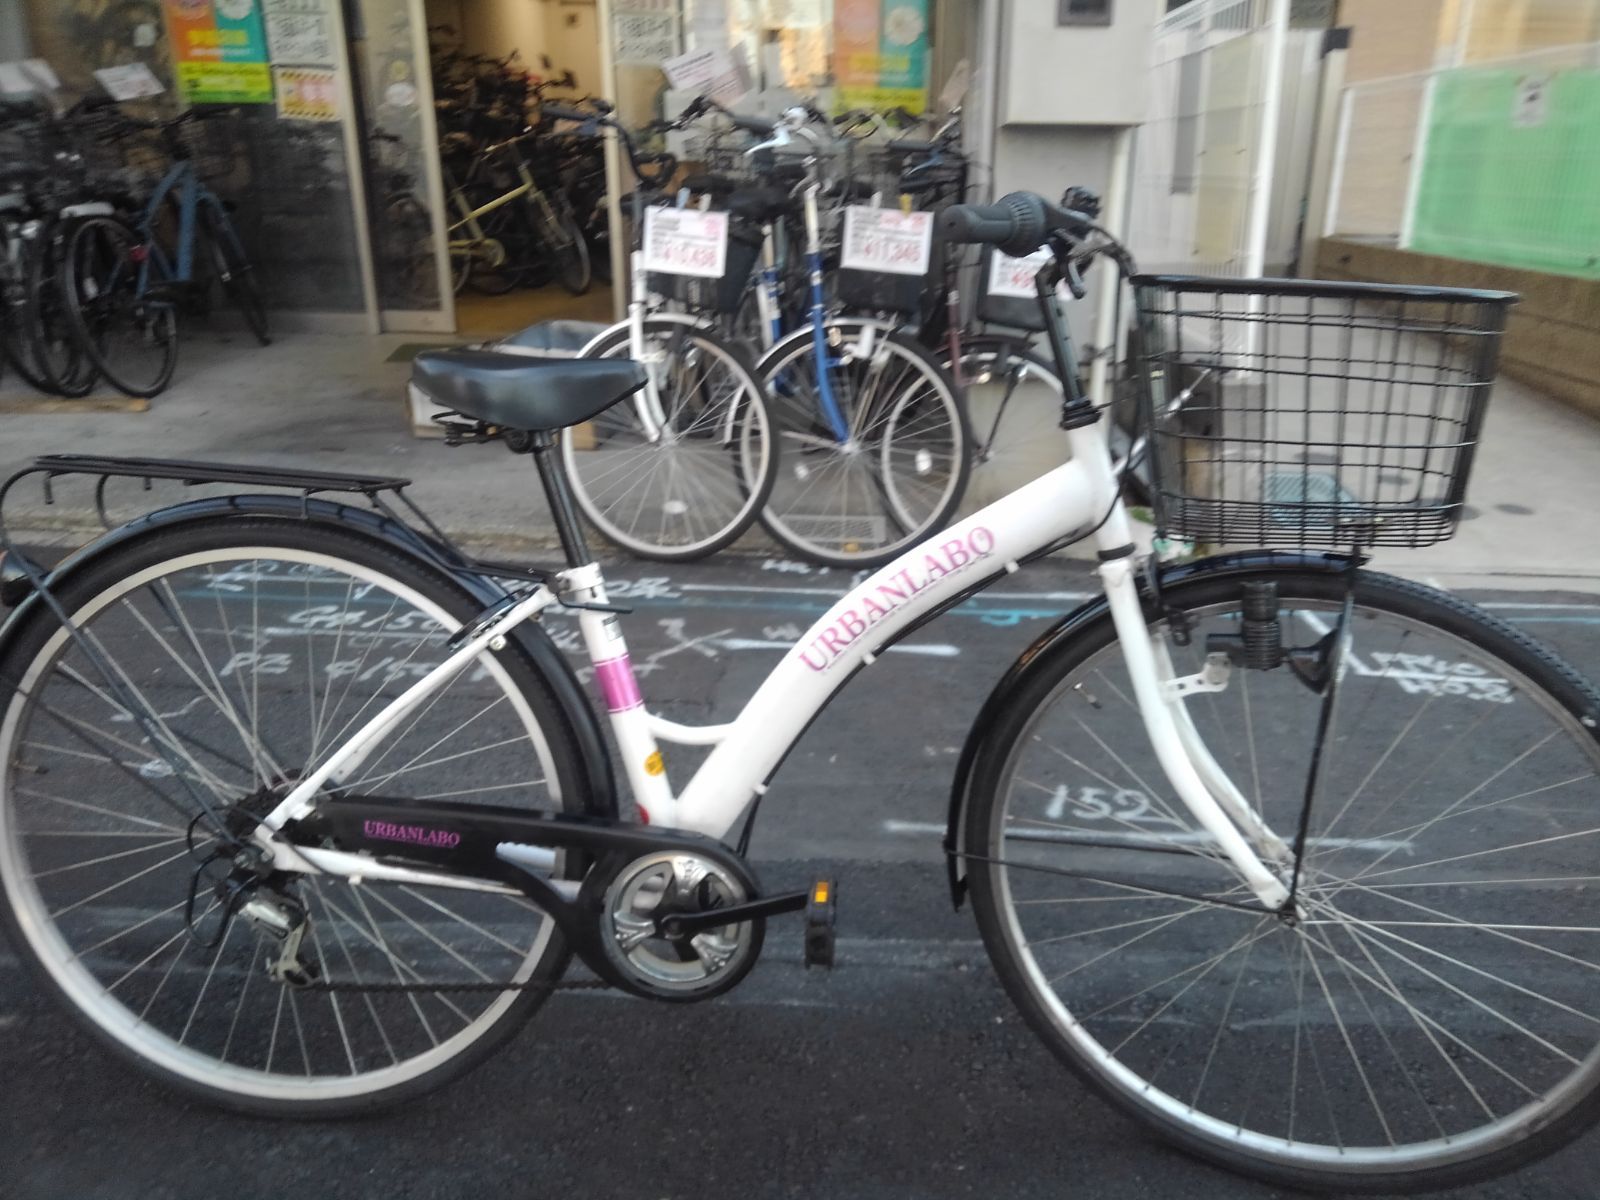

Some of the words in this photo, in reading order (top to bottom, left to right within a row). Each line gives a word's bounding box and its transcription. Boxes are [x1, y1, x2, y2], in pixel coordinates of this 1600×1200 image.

[798, 526, 995, 672] URBANLABO
[1045, 784, 1172, 823] 152
[363, 819, 461, 848] URBANLABO
